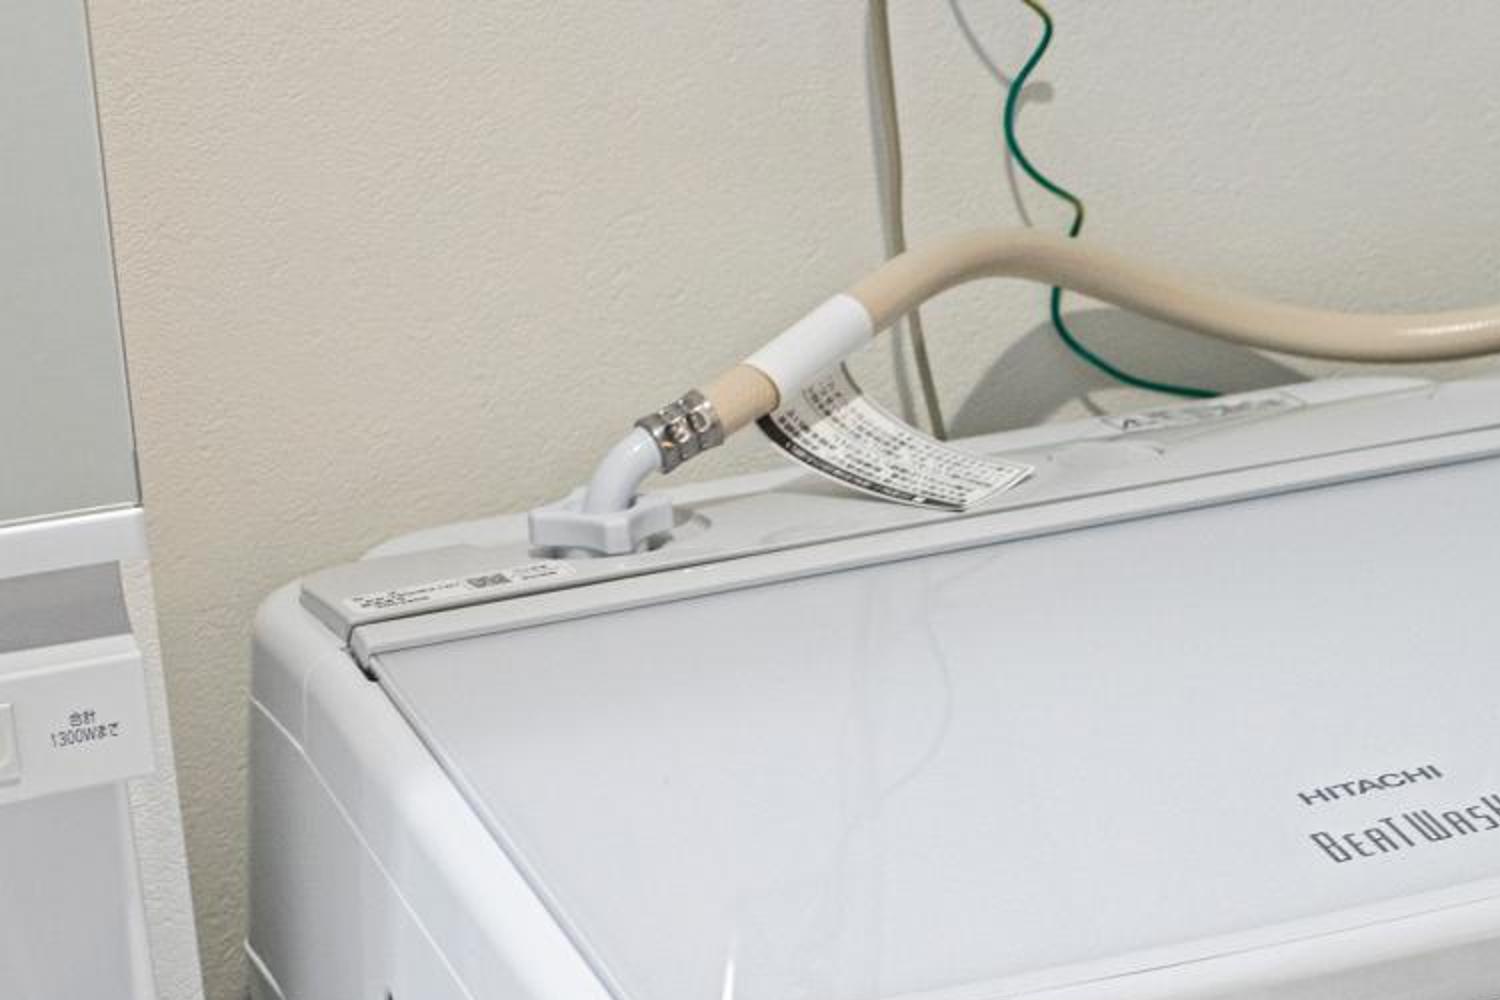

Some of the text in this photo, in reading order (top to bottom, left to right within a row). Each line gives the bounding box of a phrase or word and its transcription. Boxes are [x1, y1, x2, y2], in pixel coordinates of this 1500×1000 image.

[69, 710, 96, 727] 合計
[51, 722, 119, 748] 1300Wまで
[1297, 765, 1444, 806] HITACHI
